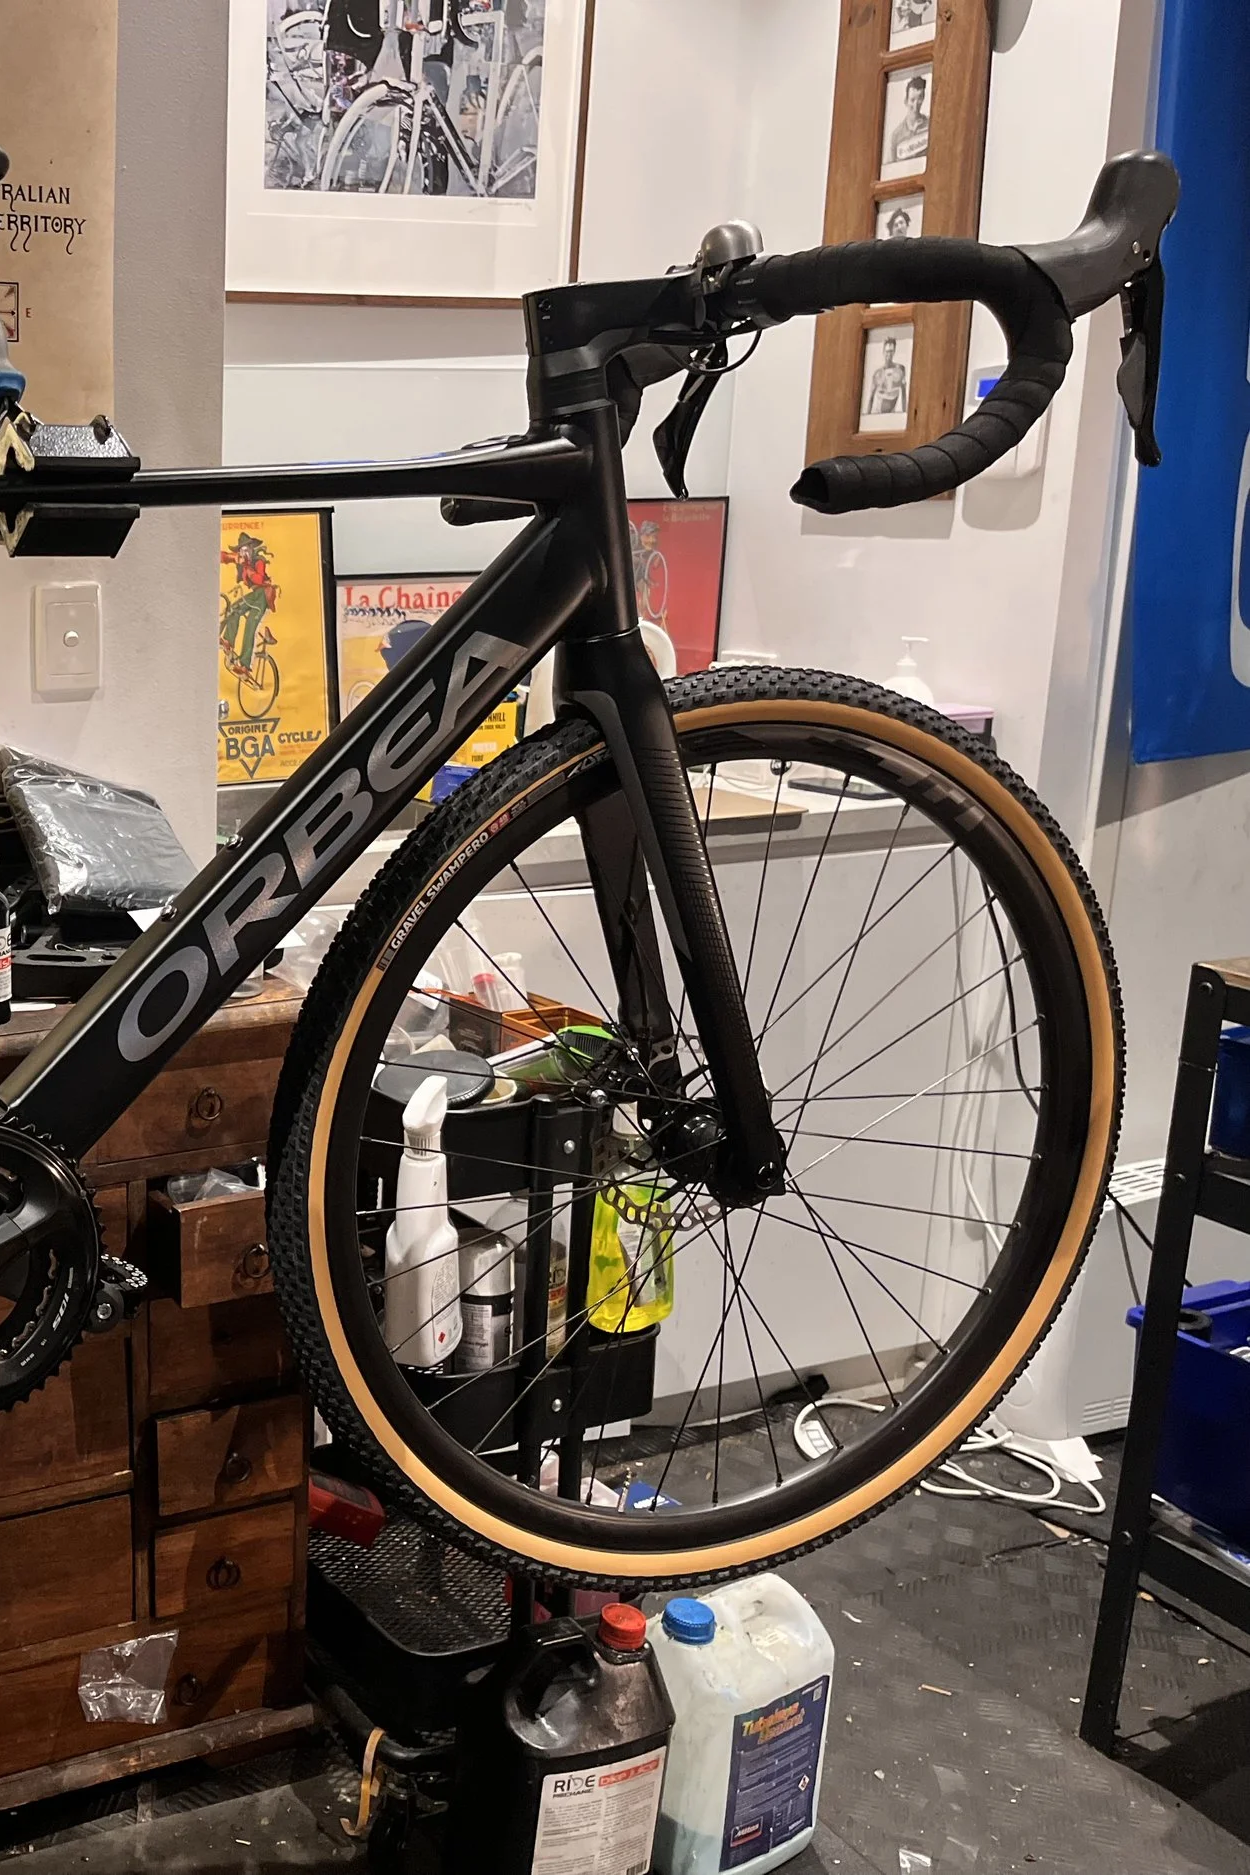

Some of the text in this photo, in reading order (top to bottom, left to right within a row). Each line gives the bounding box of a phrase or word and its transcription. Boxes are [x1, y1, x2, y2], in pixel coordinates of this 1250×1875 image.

[25, 307, 32, 318] E
[227, 723, 268, 736] ORIGINE
[225, 734, 276, 761] BGA
[277, 730, 322, 744] CYCLES
[117, 631, 528, 1062] ORBEA
[390, 899, 430, 950] GRAVEL
[426, 831, 489, 901] SWAMPERO
